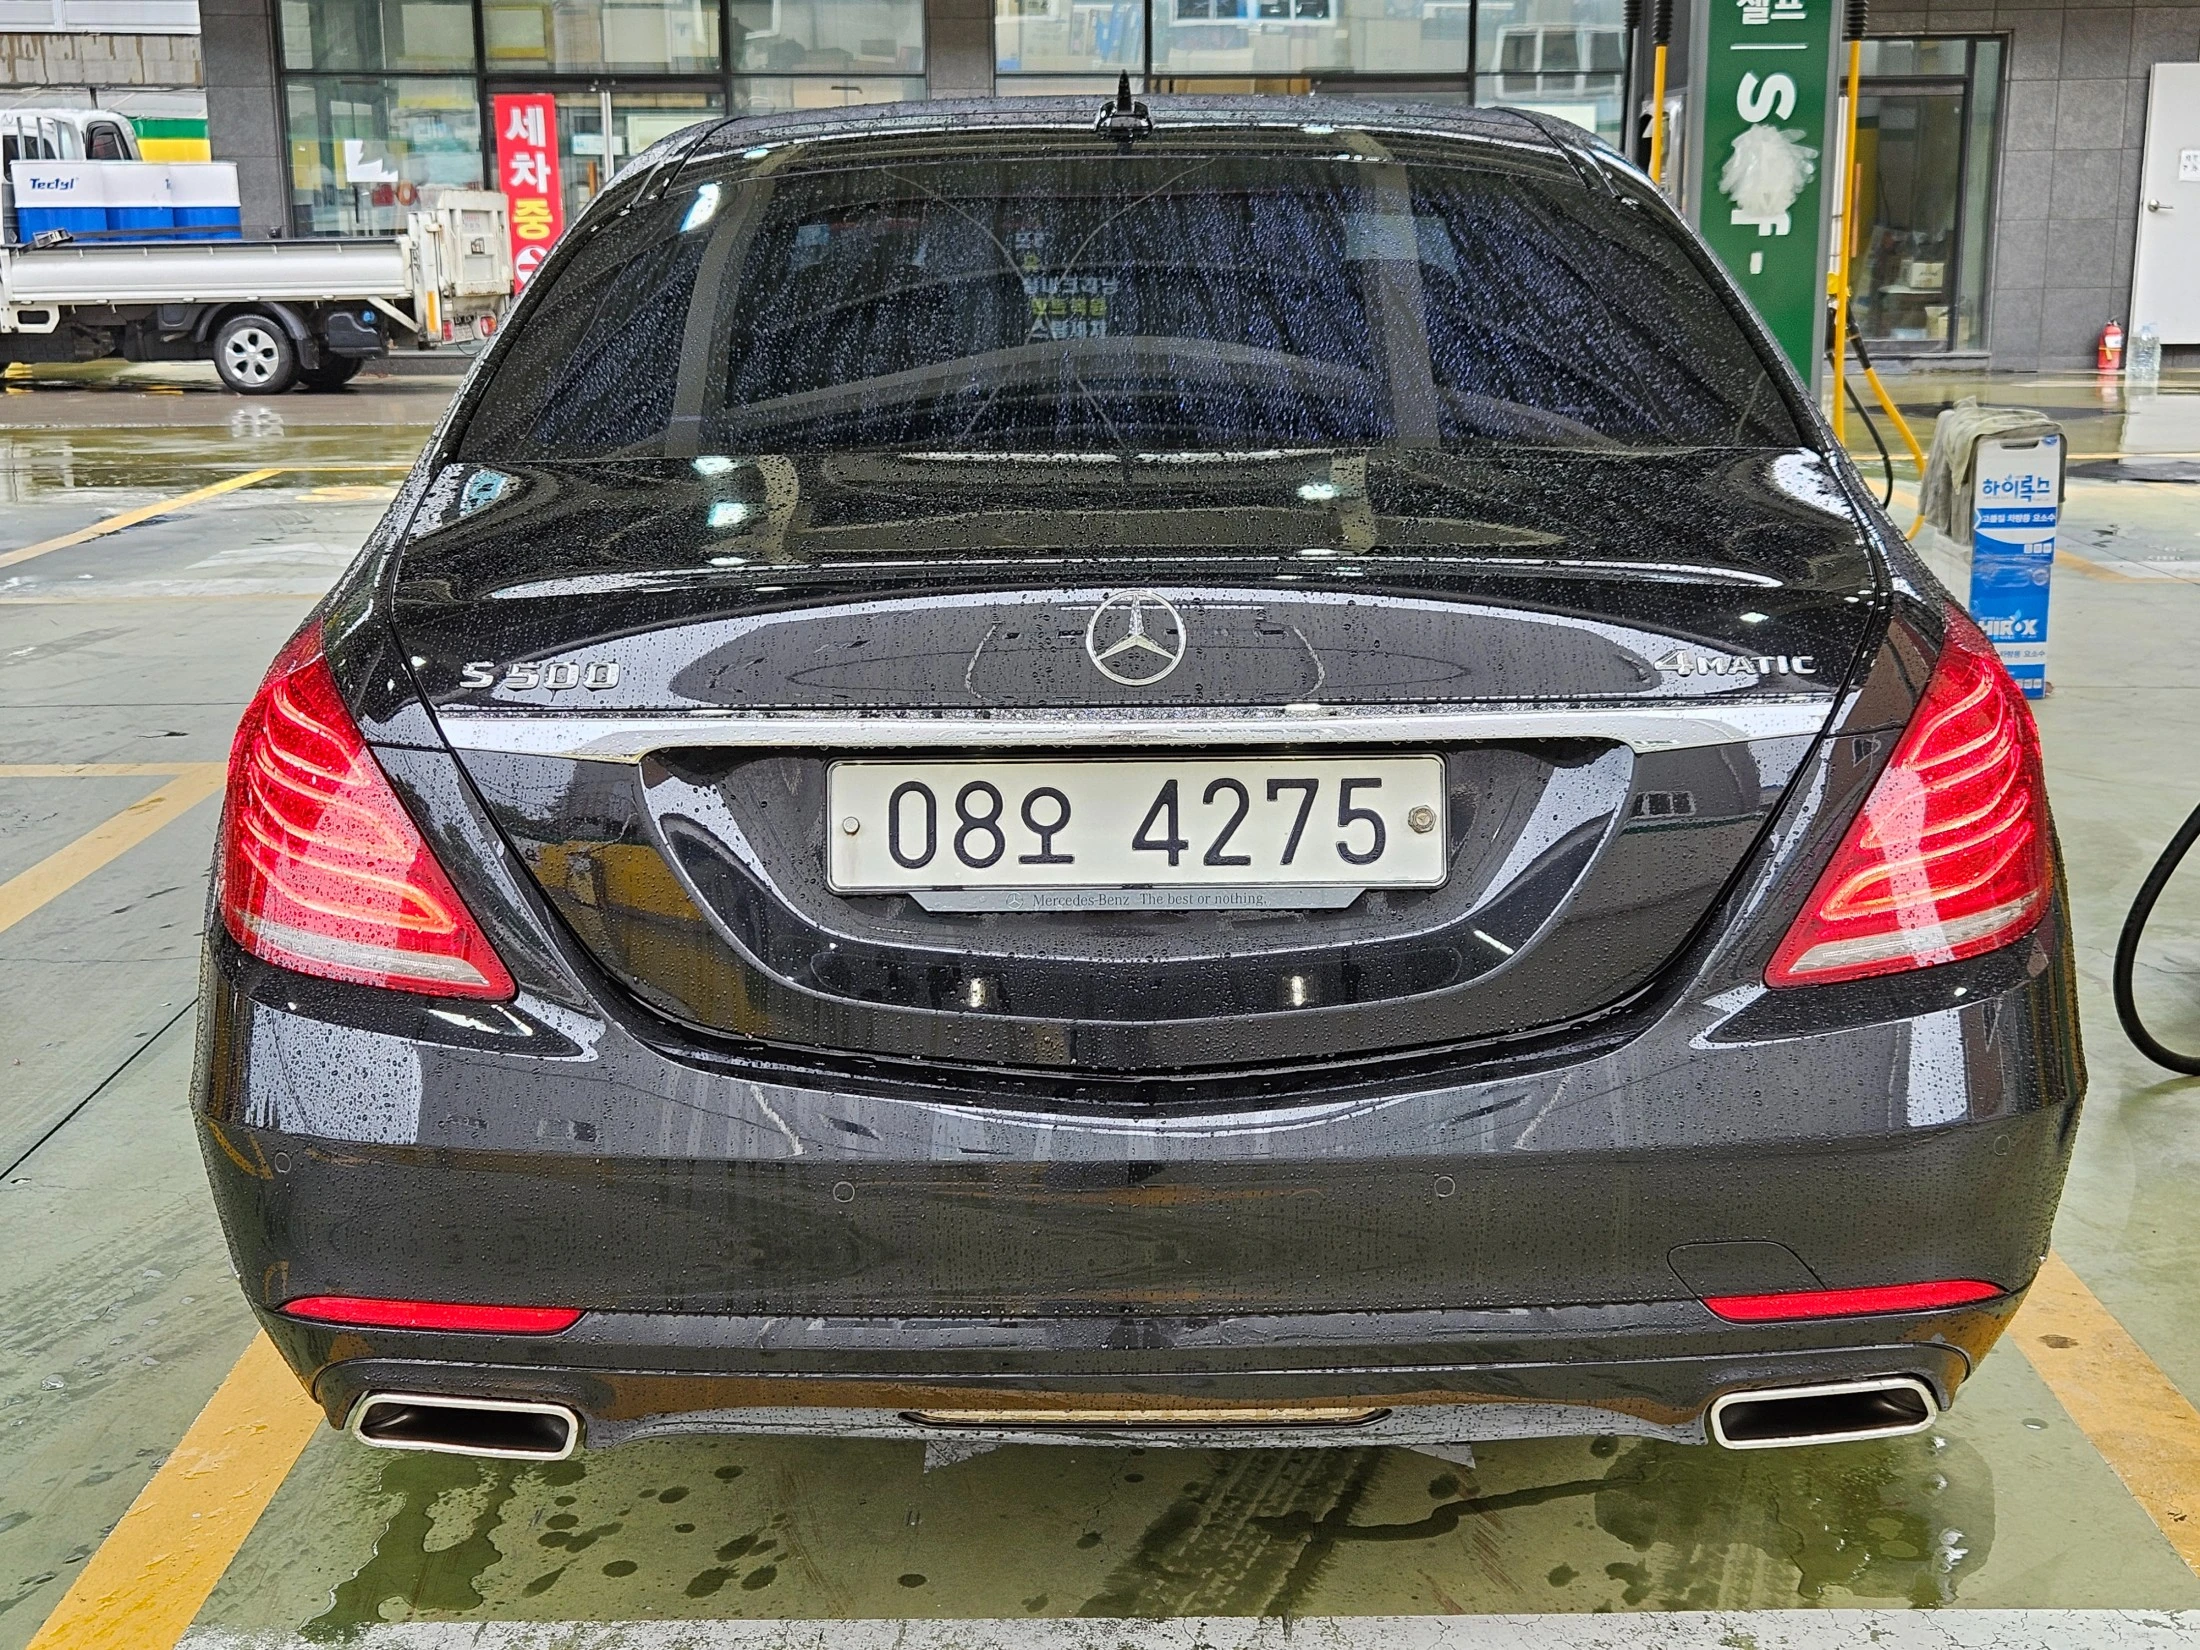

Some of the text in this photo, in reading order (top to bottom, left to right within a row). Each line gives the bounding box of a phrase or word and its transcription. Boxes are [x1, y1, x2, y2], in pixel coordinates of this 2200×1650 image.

[30, 178, 74, 190] Tectyl
[505, 104, 552, 240] 세차중
[1982, 475, 2050, 502] 하이록스
[2032, 512, 2056, 523] 요소수
[459, 660, 621, 690] S 500
[1653, 648, 1817, 676] 4MATIC
[888, 778, 1386, 869] 08오 4275
[1033, 893, 1130, 907] Mercedes-Benz
[1140, 893, 1164, 905] The
[1167, 892, 1193, 905] best
[1197, 895, 1211, 905] or
